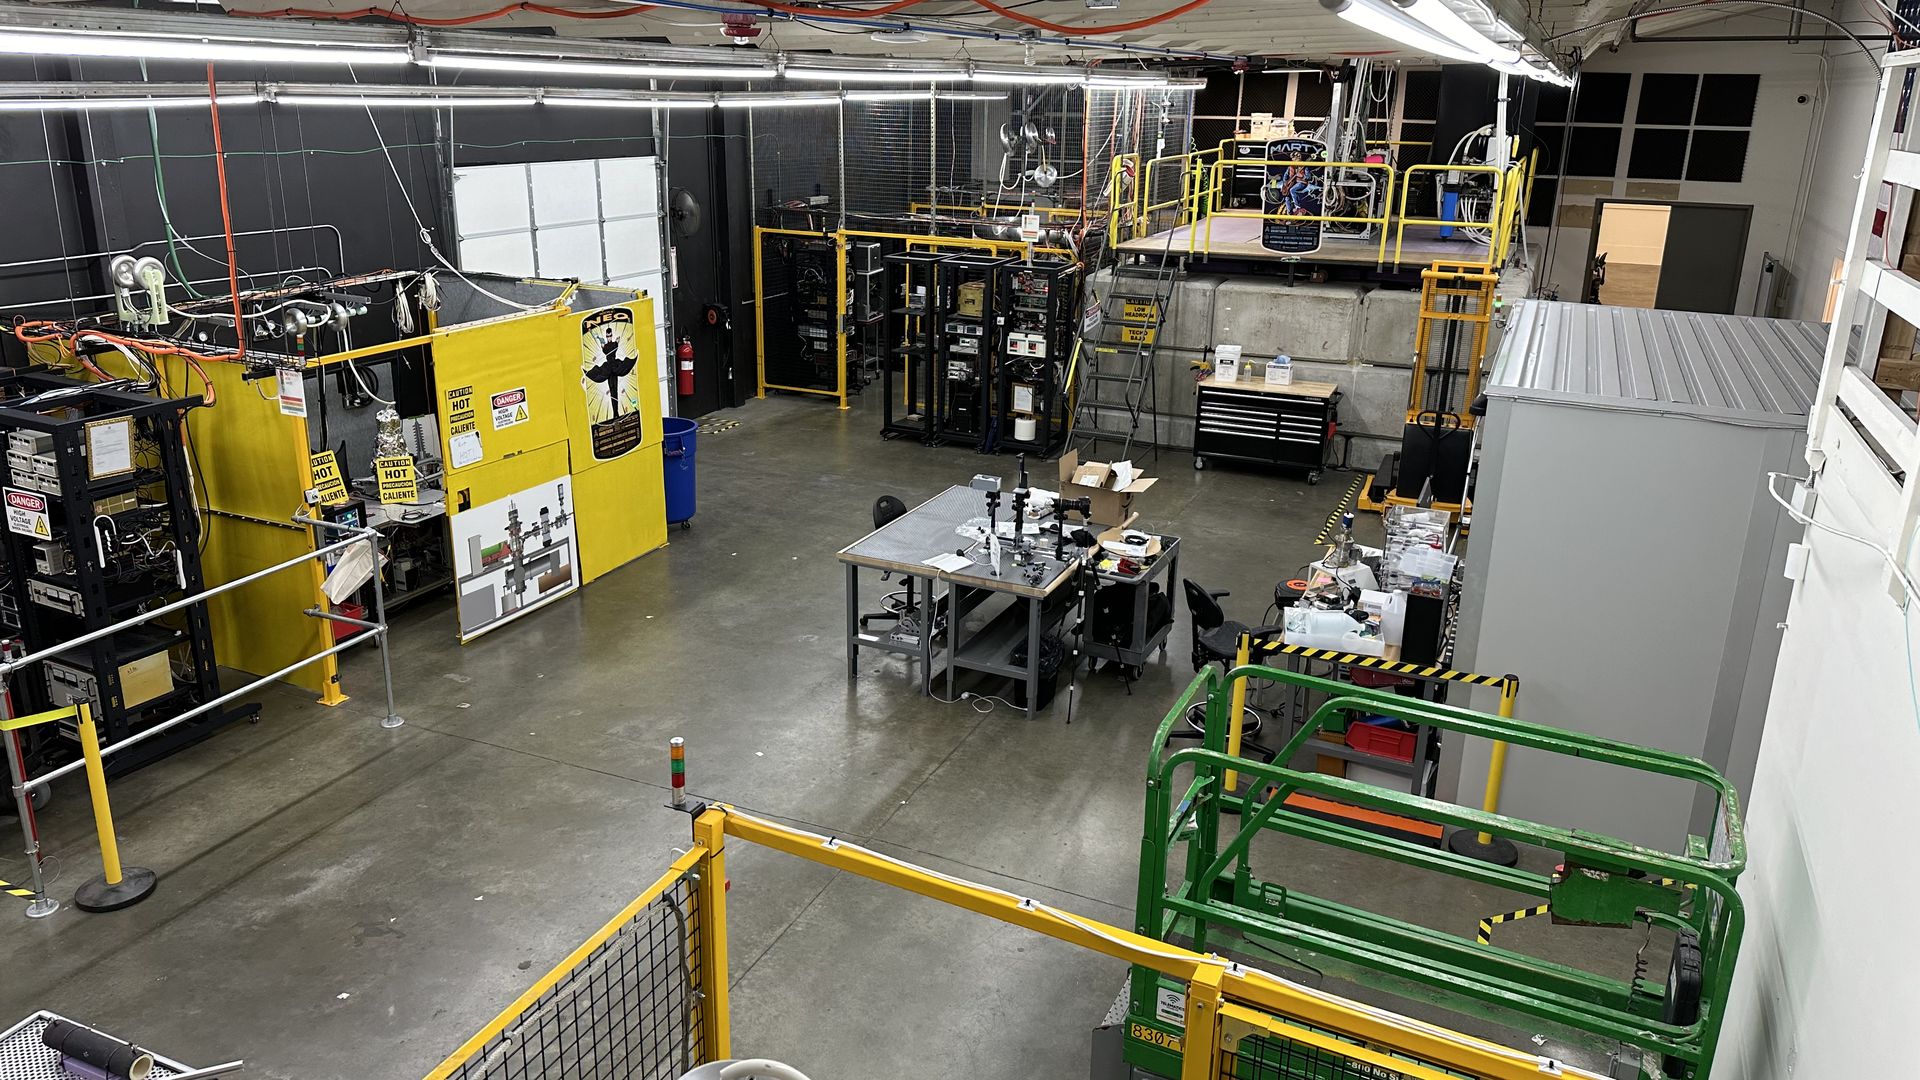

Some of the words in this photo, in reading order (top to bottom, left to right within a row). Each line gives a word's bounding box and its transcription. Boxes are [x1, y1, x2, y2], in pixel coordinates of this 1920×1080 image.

[1270, 143, 1323, 155] MARTY
[585, 312, 629, 329] NEO
[448, 387, 473, 398] CAUTION
[452, 398, 470, 411] HOT
[496, 393, 521, 406] DANGER
[495, 412, 513, 421] VOLTAGE
[450, 421, 475, 435] CALIENTE
[312, 455, 333, 466] UTION
[379, 459, 410, 467] CAUTION
[313, 466, 333, 480] HOT
[385, 468, 408, 479] HOT
[320, 489, 346, 502] ALIENTE
[383, 490, 415, 501] CALIENTE
[11, 495, 41, 509] DANGER
[10, 515, 31, 525] VOLTAGE
[1372, 1067, 1387, 1078] No
